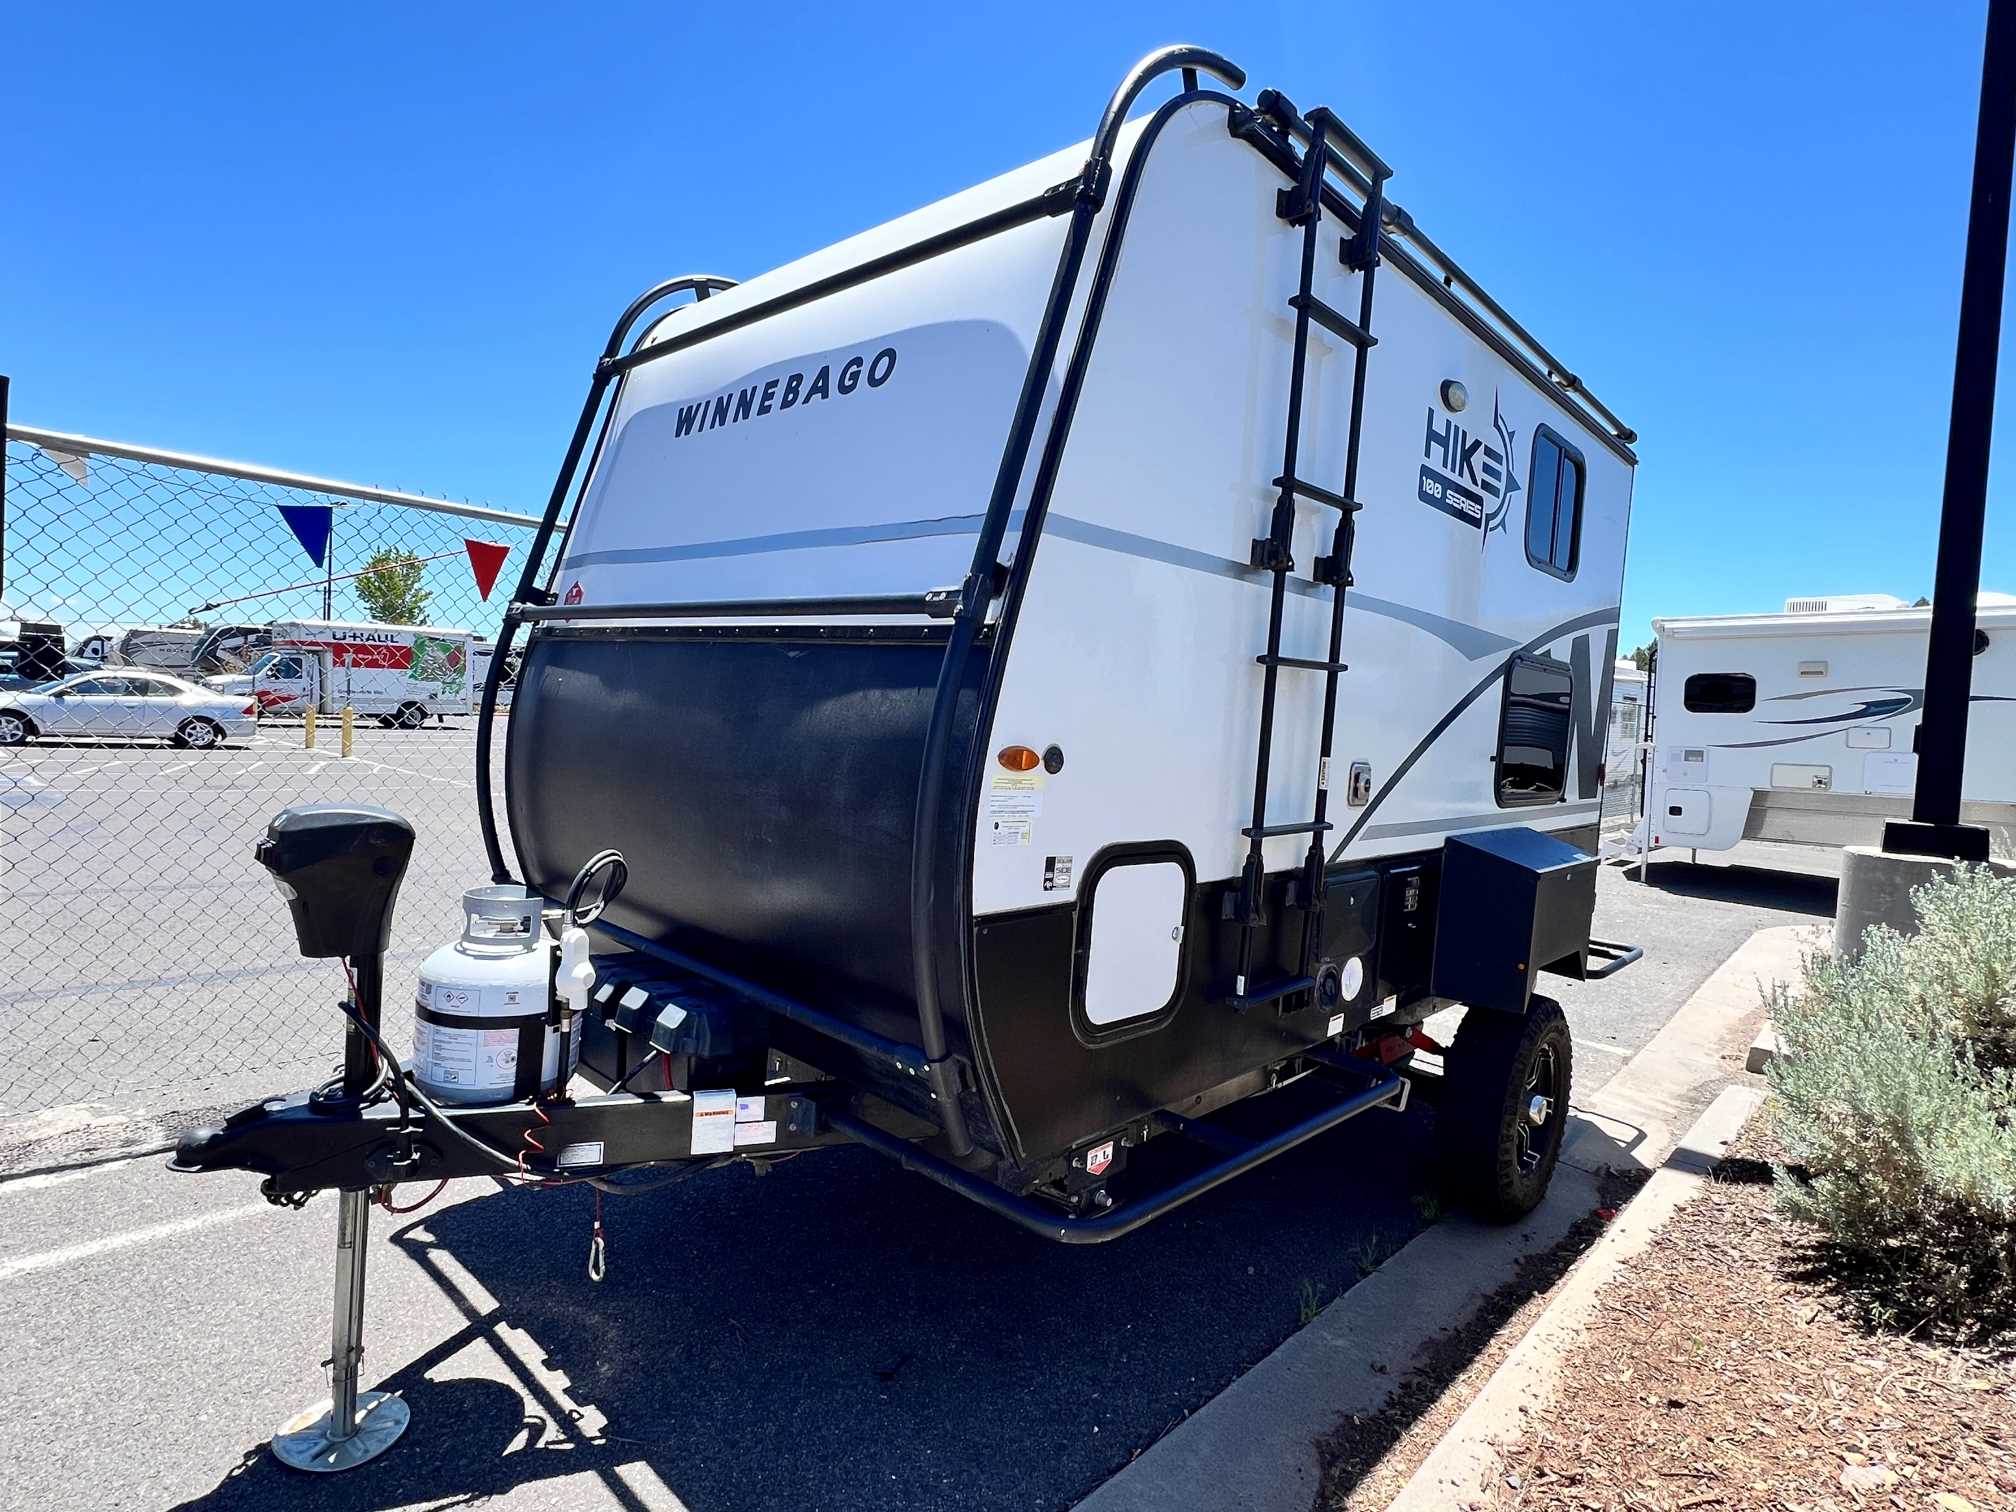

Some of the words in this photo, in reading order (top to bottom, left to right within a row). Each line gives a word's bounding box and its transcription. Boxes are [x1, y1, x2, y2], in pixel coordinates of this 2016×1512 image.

[674, 347, 897, 438] WINNEBAGO
[1422, 475, 1442, 499] 100
[1445, 489, 1482, 519] SERIES
[1424, 406, 1503, 499] HIKE
